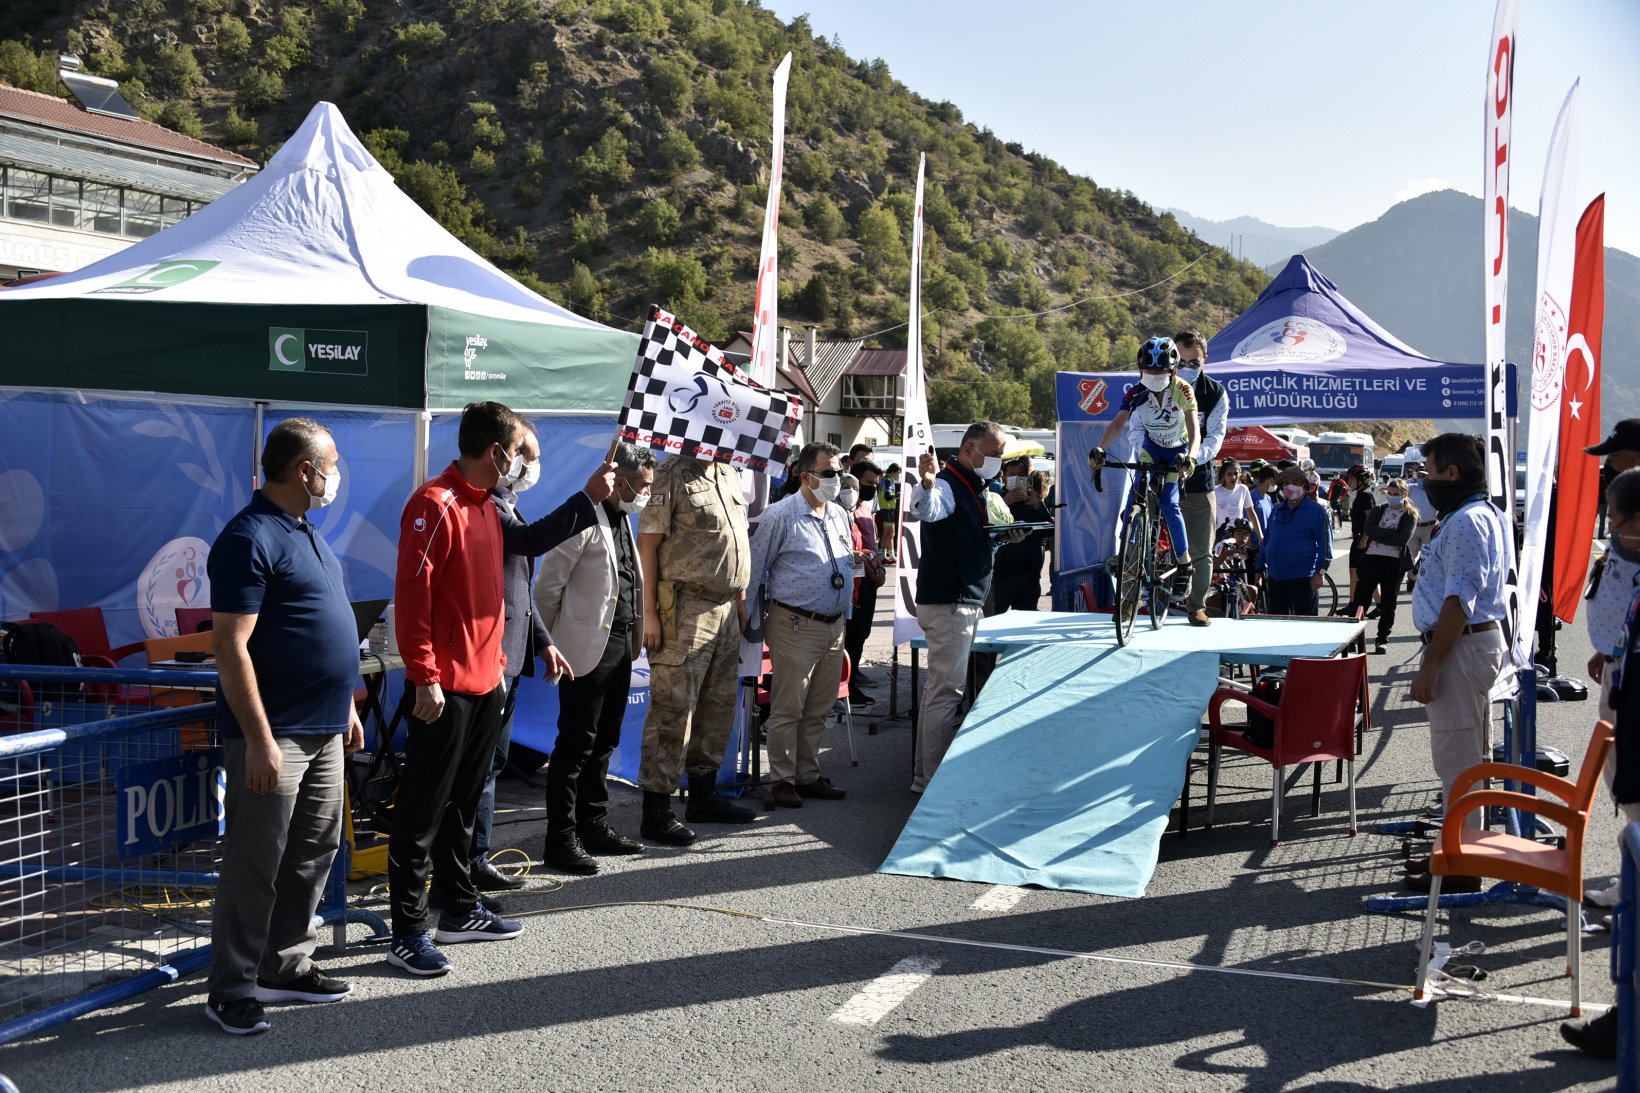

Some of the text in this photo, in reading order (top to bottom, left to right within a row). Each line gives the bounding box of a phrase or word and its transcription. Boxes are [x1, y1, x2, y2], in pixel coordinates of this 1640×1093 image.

[653, 311, 711, 353] SALCANO
[1227, 373, 1299, 392] GENÇLİK
[1302, 374, 1400, 391] HİZMETLERİ
[1404, 378, 1427, 391] VE
[1235, 393, 1250, 410] İL
[1253, 391, 1358, 409] MÜDÜRLÜĞÜ
[619, 429, 768, 469] SALCANO SALCANO
[124, 754, 227, 846] POLİS
